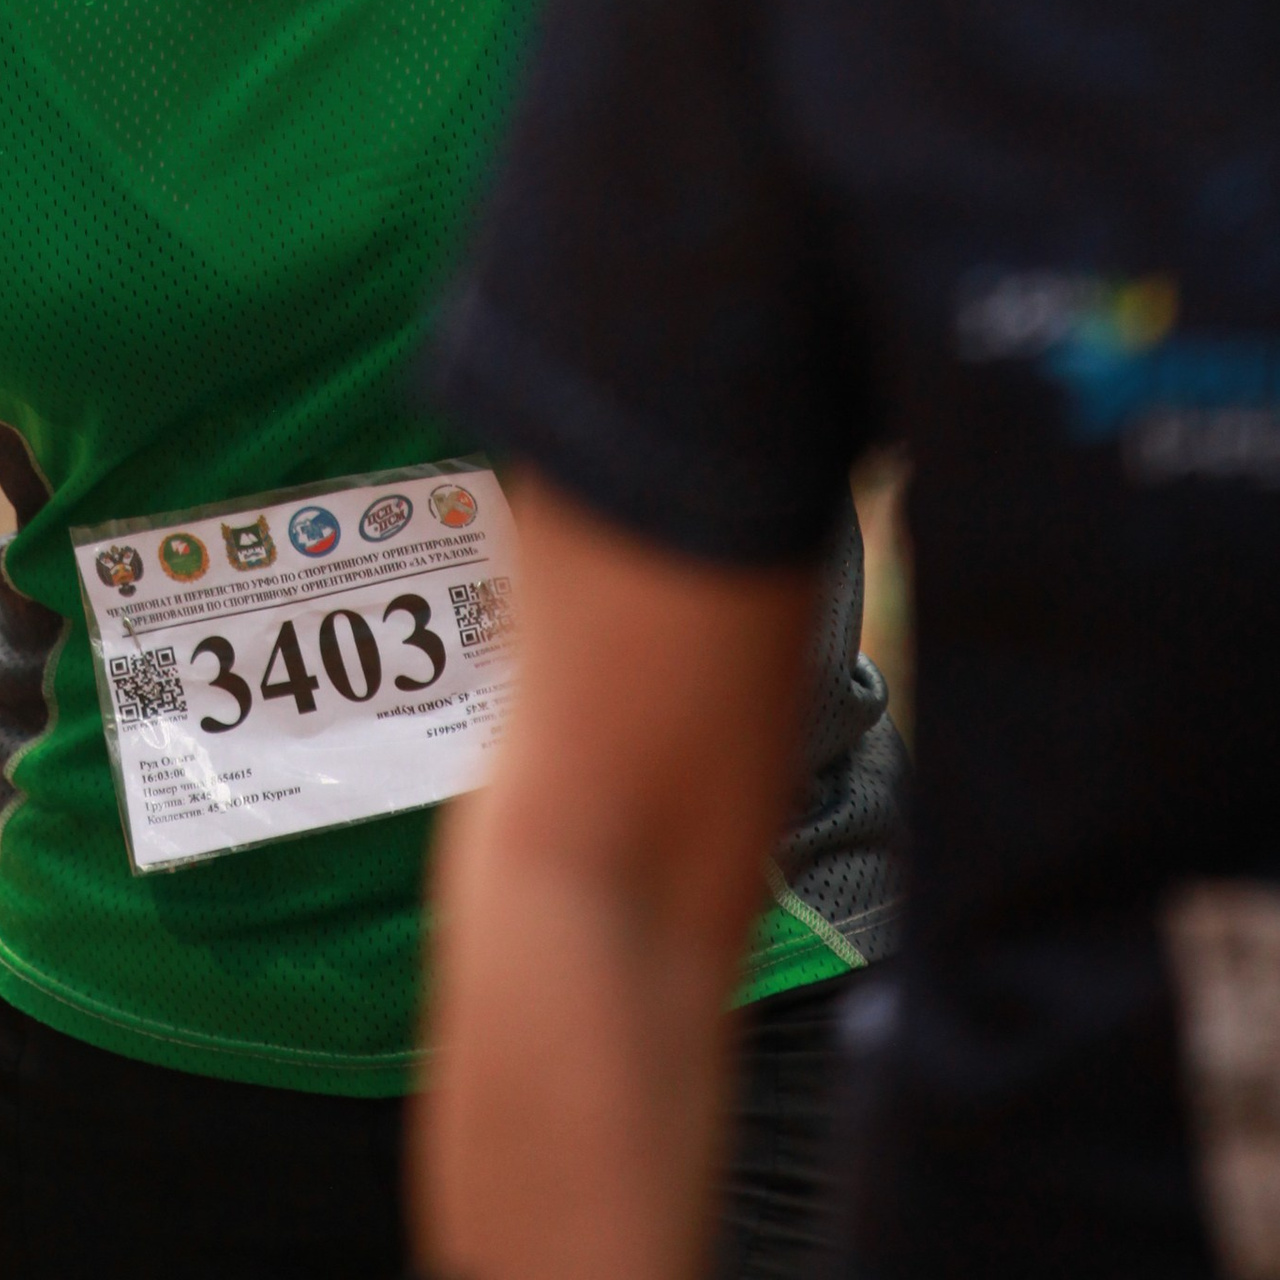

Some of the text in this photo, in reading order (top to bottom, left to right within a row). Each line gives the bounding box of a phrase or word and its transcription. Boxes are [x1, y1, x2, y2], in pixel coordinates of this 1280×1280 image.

[106, 531, 487, 619] ЧЕМПИОНАТ И ПЕРВЕНСТВО УРФО ПО СПОРТИВНОМУ ОРИЕНТИРОВАНИЮ
[125, 606, 206, 629] ОРЕВНОВАНИЯ
[207, 601, 222, 613] ПО
[223, 586, 298, 609] СПОРТИВНОМУ
[301, 560, 407, 594] ОРИЕНТИРОВАНИЮ
[189, 593, 447, 734] 3403
[376, 704, 416, 720] Курган
[426, 721, 469, 738] 8654615
[143, 784, 178, 799] Номер
[145, 797, 186, 813] Группа:
[147, 808, 205, 825] Коллектив:
[262, 785, 302, 802] Курган
